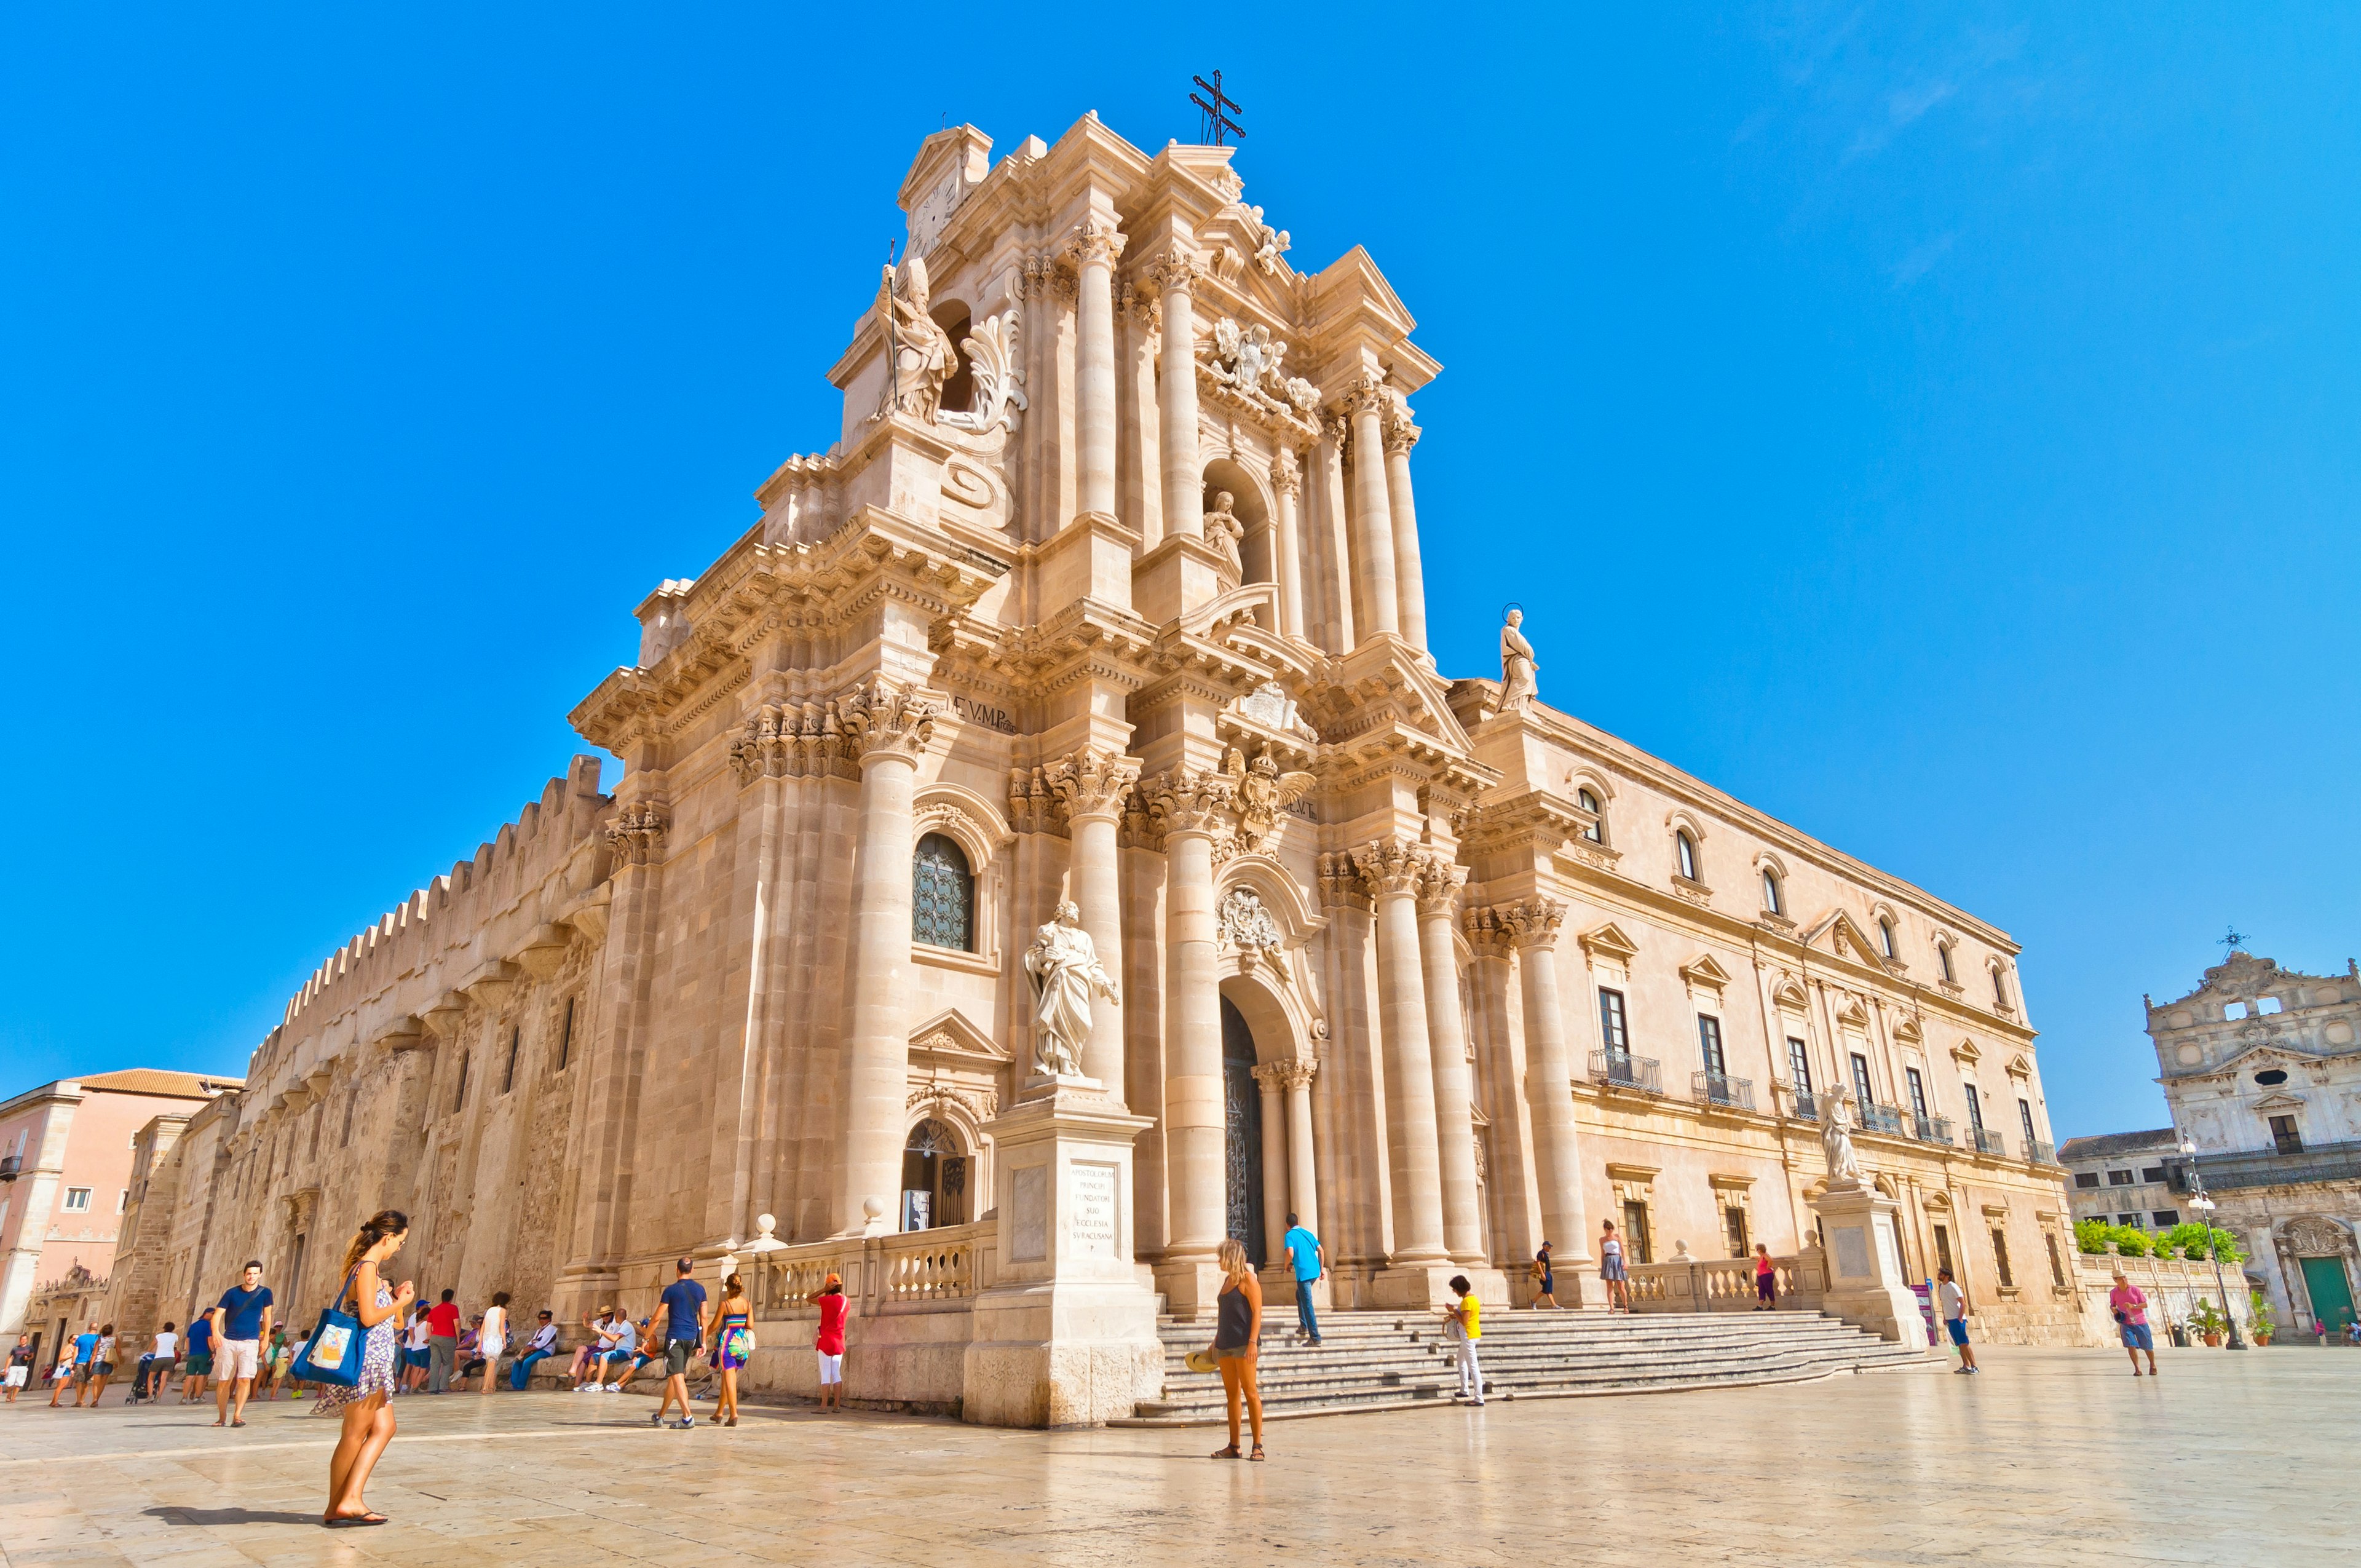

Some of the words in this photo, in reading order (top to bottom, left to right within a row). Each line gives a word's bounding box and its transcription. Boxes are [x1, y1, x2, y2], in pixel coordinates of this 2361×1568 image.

[1071, 1169, 1115, 1179] APOSTOLORUM
[1080, 1181, 1105, 1190] PRINCIPI
[1075, 1194, 1110, 1203] FUNDATORI
[1076, 1219, 1109, 1228] ECCLESIA
